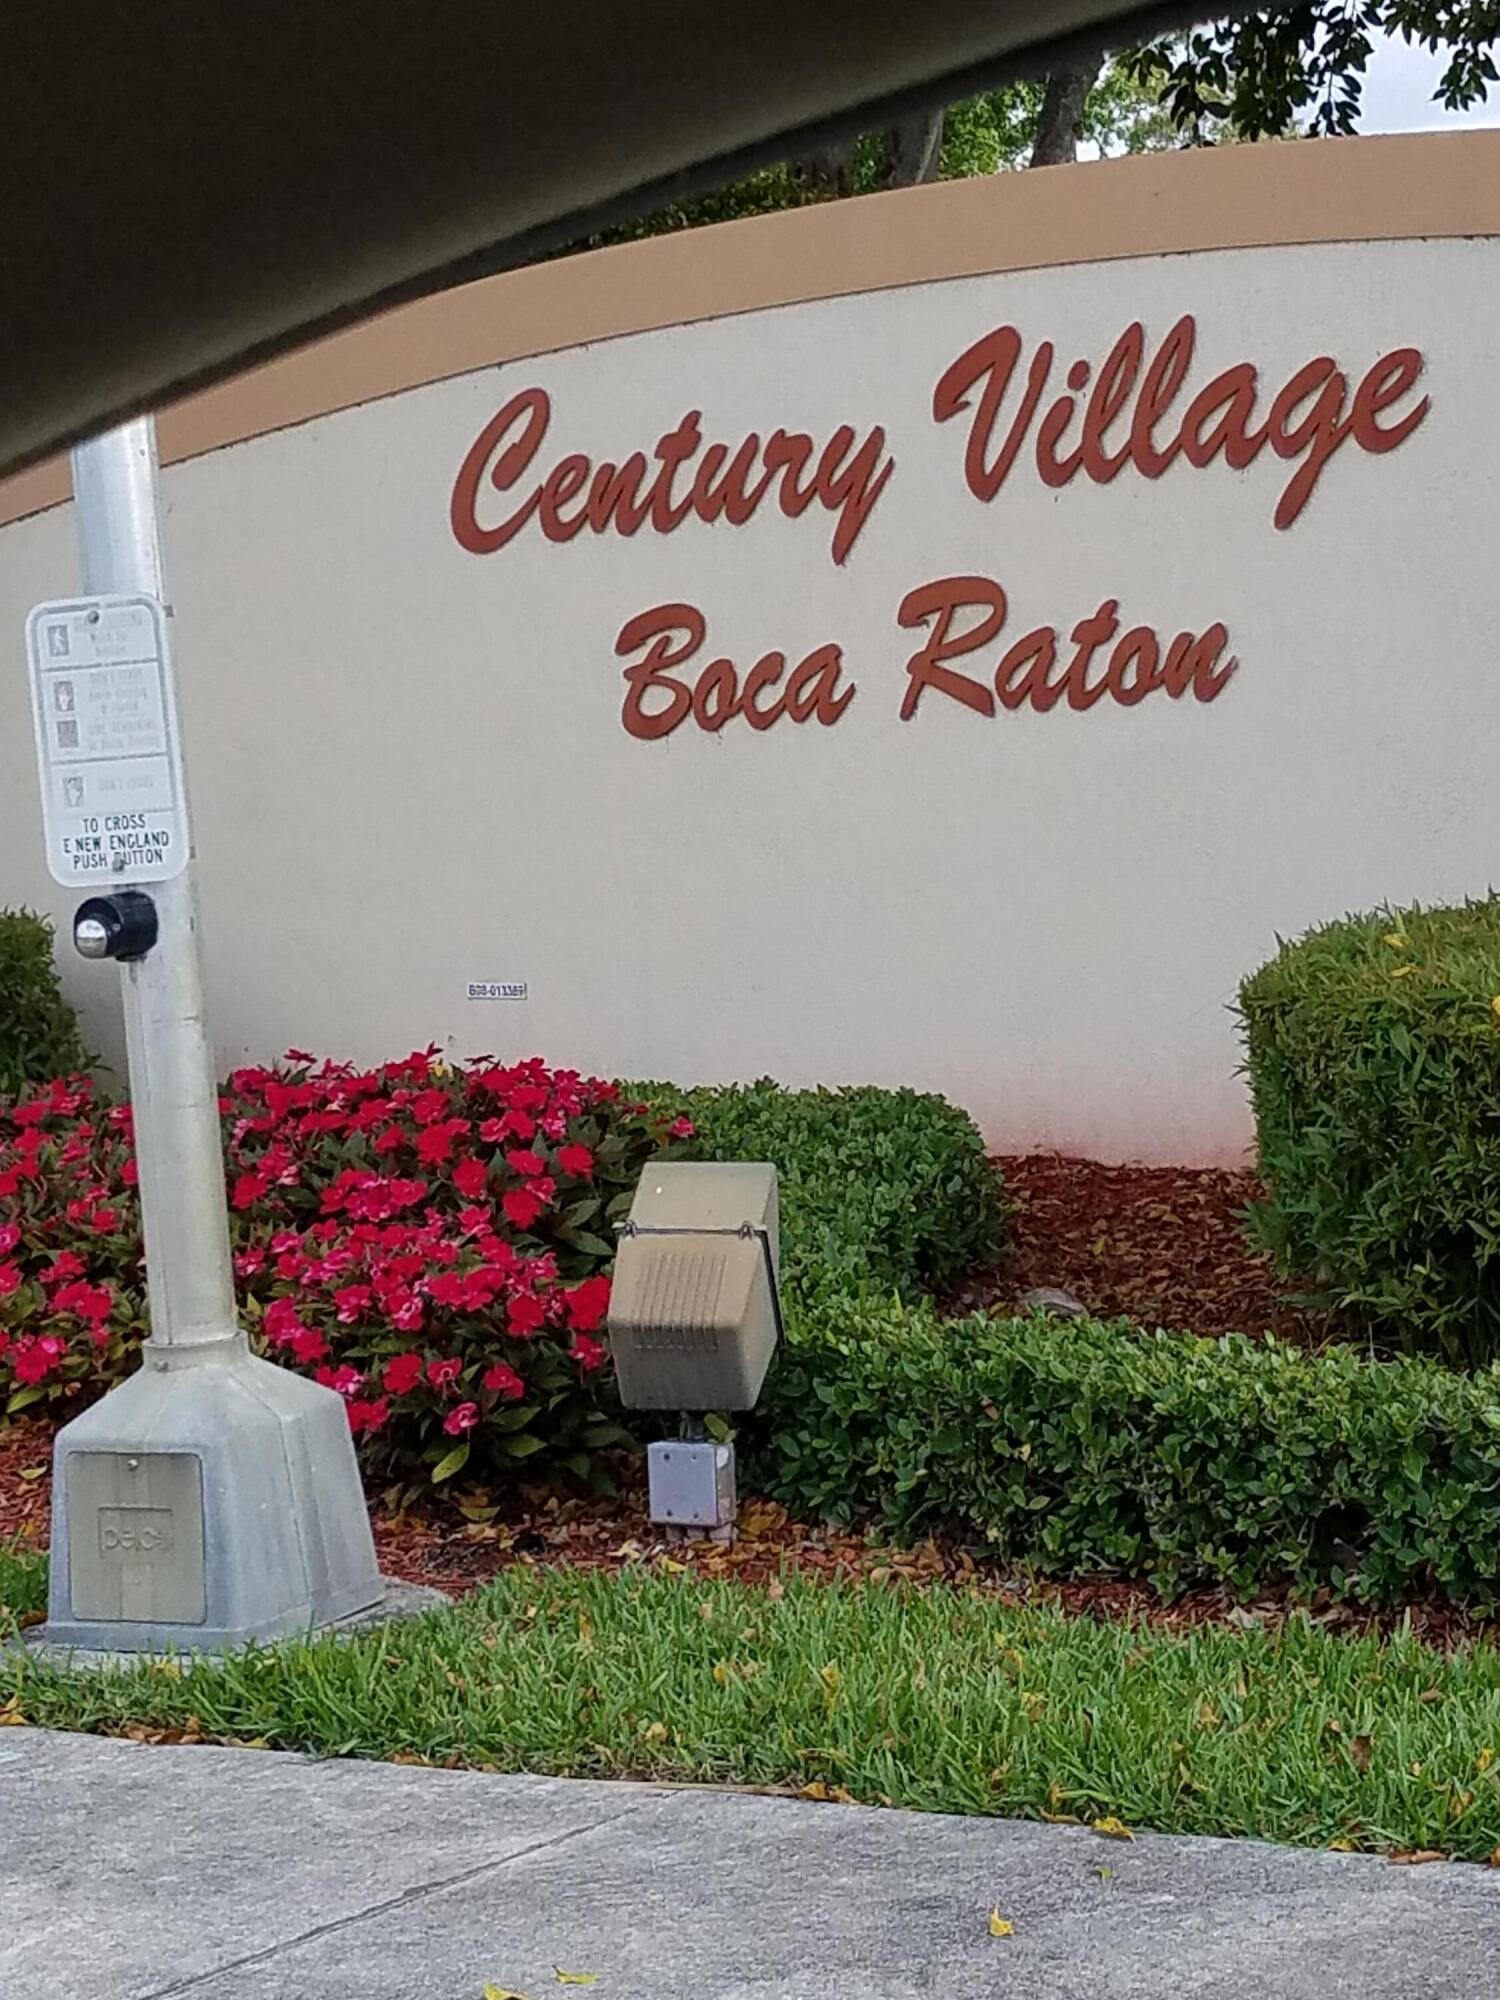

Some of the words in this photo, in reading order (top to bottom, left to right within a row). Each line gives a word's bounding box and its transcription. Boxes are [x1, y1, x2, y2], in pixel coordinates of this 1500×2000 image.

[451, 387, 893, 565] Century
[934, 315, 1430, 529] Village
[615, 604, 854, 740] Boca
[899, 577, 1238, 721] Raton
[83, 818, 98, 833] TO
[105, 814, 146, 832] CROSS
[63, 838, 71, 853] E
[75, 837, 101, 851] NEW
[109, 831, 169, 850] ENGLAND
[73, 853, 107, 869] PUSH
